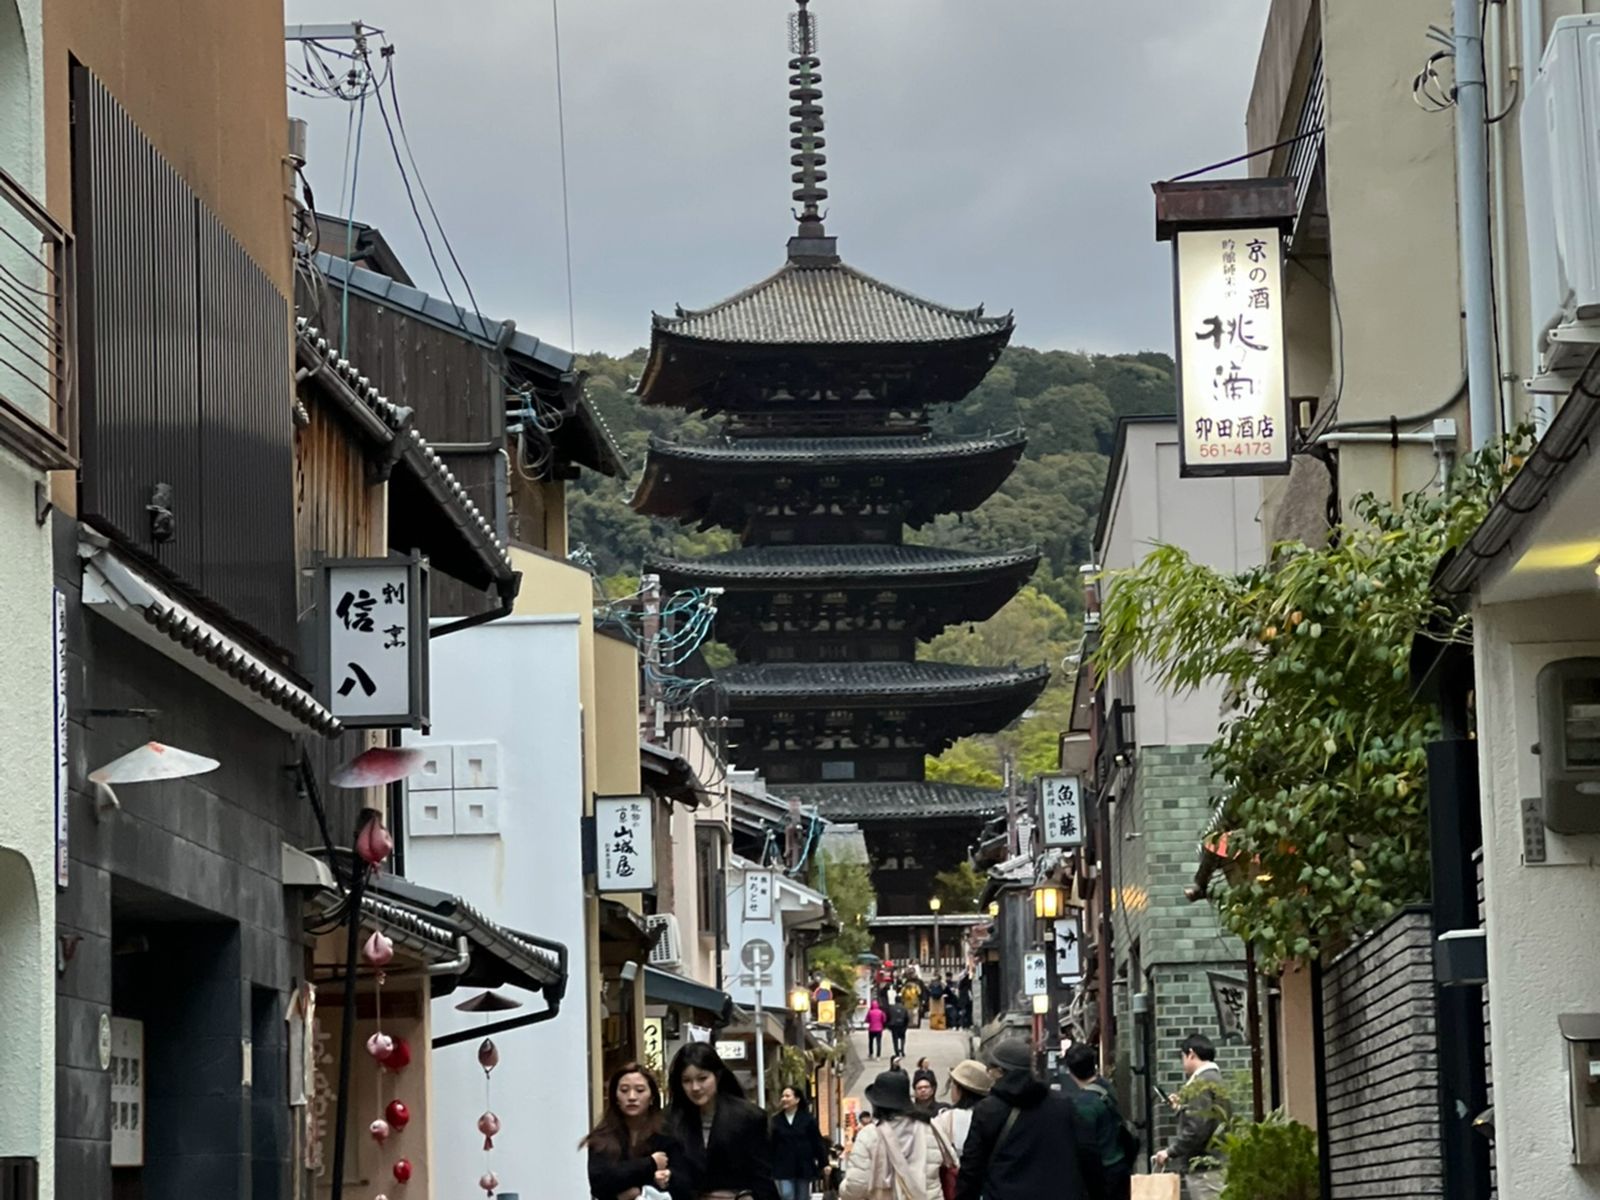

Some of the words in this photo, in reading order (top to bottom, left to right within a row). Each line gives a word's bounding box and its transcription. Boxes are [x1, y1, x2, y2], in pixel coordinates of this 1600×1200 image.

[1245, 238, 1269, 309] 京の酒
[1195, 415, 1274, 441] 卯田酒店
[1199, 442, 1271, 457] 561-4173
[336, 589, 378, 697] 信八
[1057, 784, 1077, 836] 魚藤
